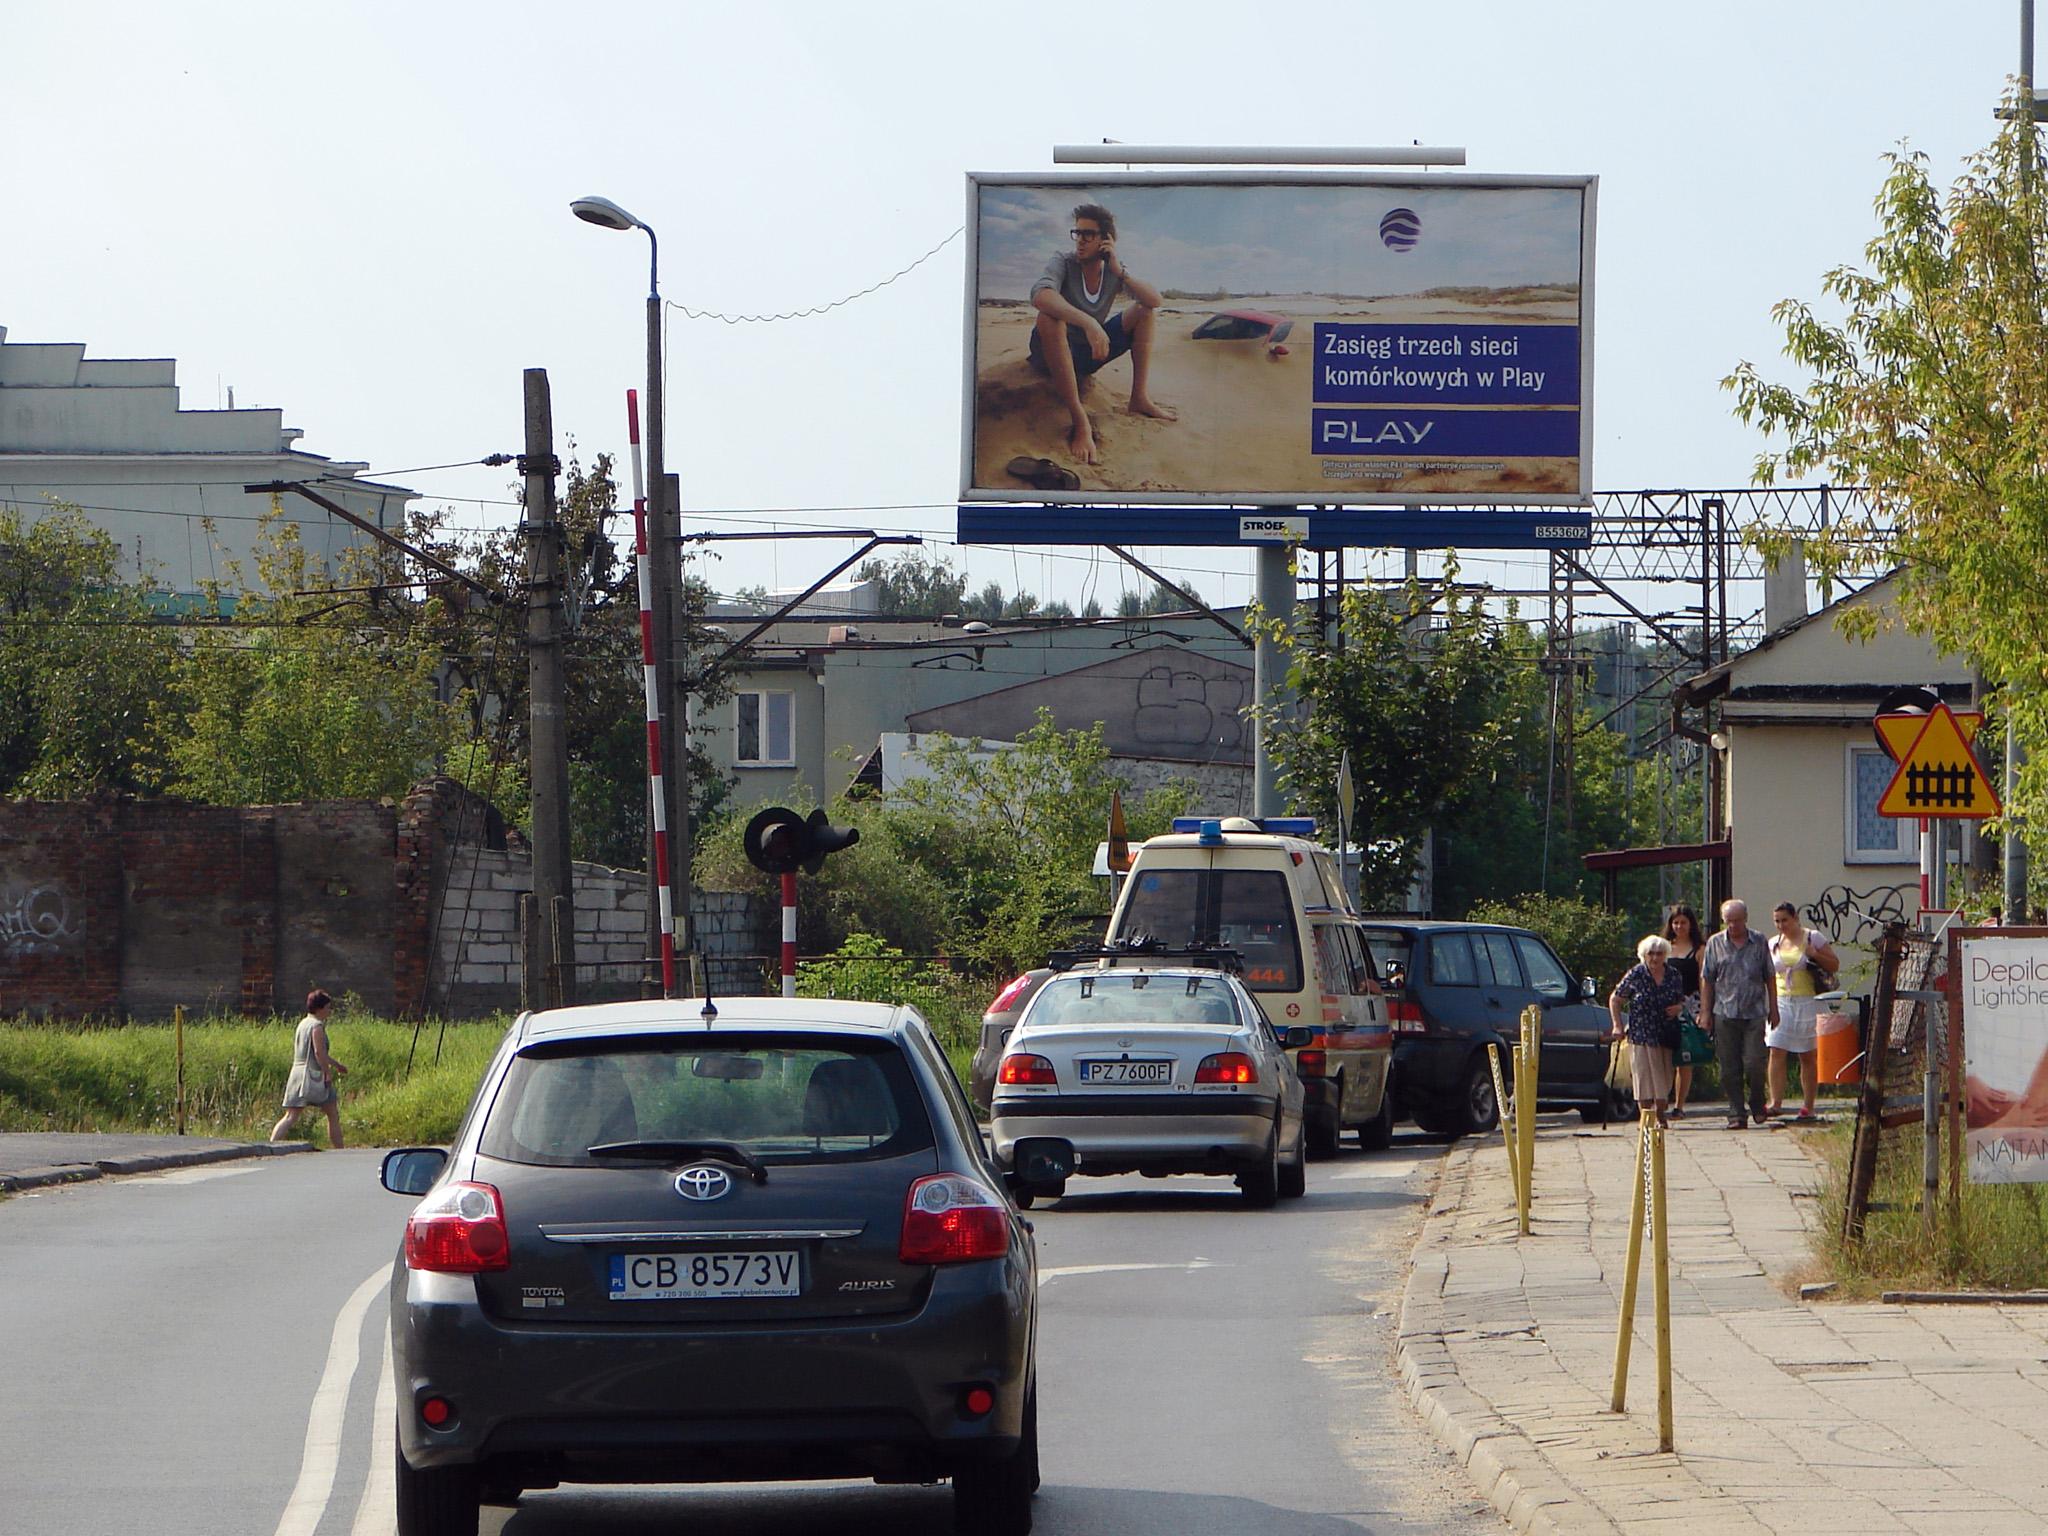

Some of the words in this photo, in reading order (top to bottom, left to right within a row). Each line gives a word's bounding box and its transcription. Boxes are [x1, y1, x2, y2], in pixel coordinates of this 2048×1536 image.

[1324, 333, 1392, 359] Zasięg
[1398, 335, 1462, 356] trzech
[1470, 336, 1518, 356] sieci
[1325, 365, 1468, 391] komórkowych
[1476, 372, 1494, 387] w
[1502, 367, 1545, 392] Play
[1323, 420, 1435, 444] PLAY
[1537, 527, 1587, 538] 8553602
[1972, 984, 2048, 1009] LightShe
[1091, 1064, 1114, 1080] PZ
[1119, 1064, 1168, 1080] 7600F
[631, 1256, 678, 1289] CB
[691, 1254, 793, 1287] 8573V
[521, 1287, 565, 1297] TOYOTA
[611, 1277, 624, 1287] PL
[838, 1279, 896, 1291] AURIS
